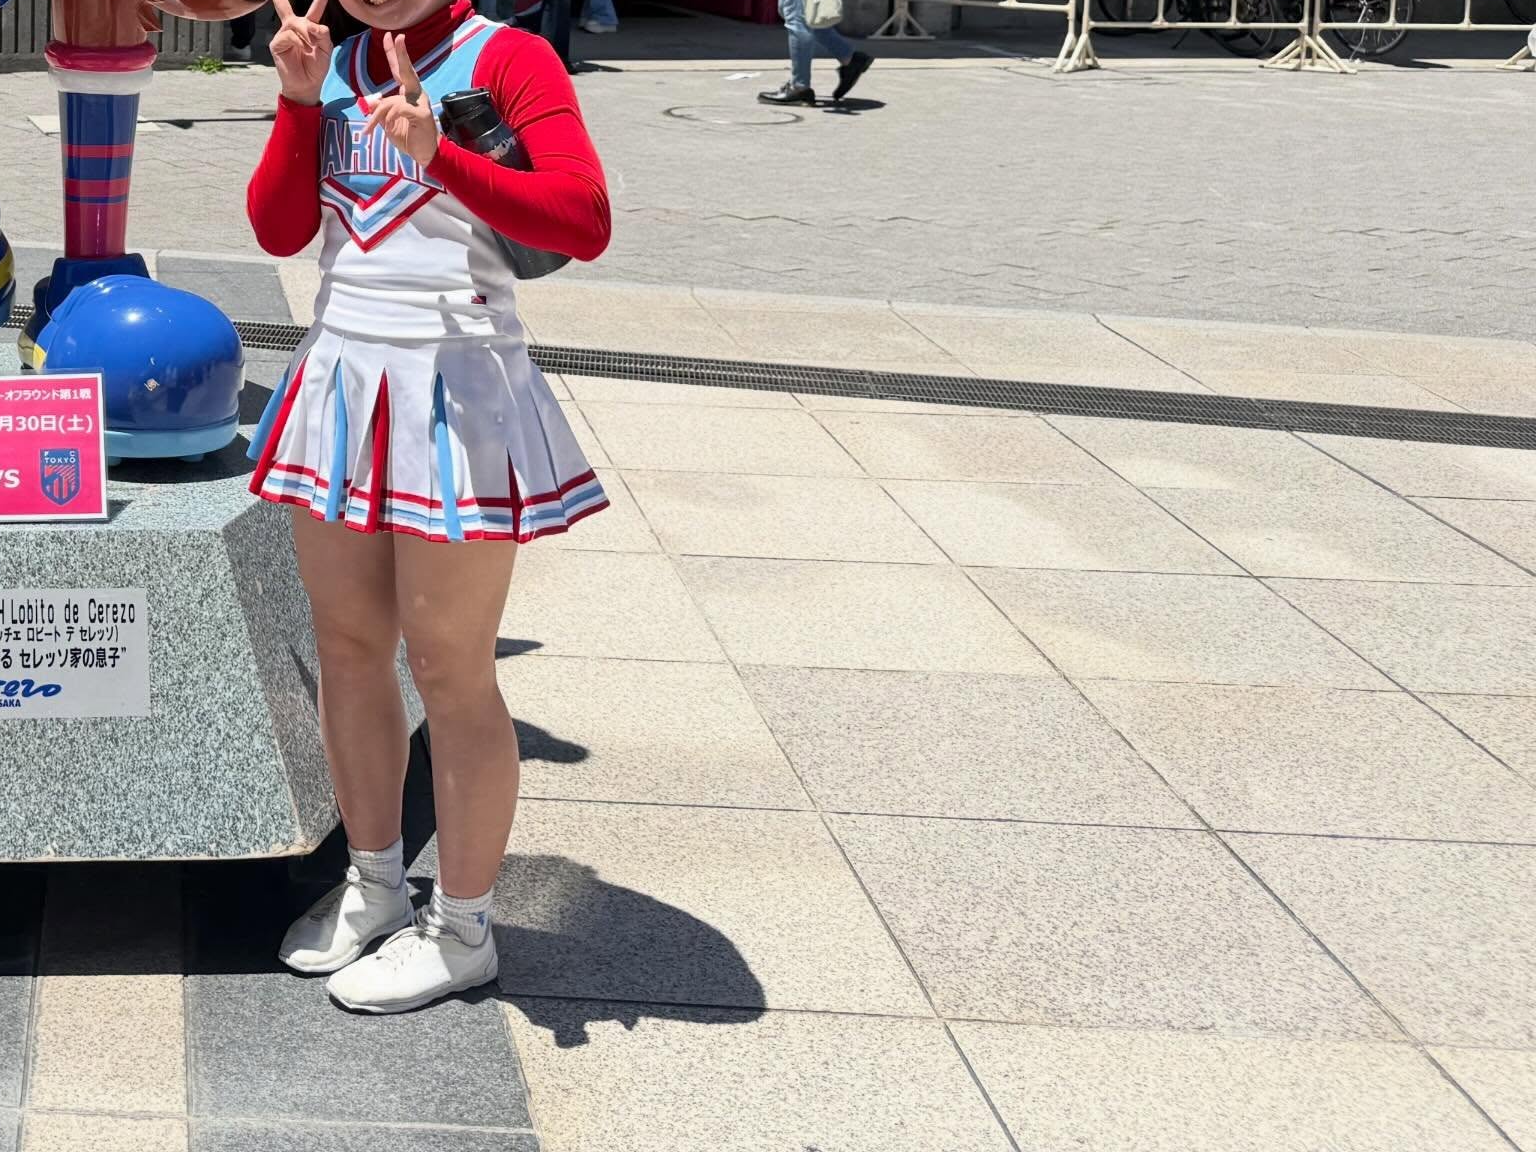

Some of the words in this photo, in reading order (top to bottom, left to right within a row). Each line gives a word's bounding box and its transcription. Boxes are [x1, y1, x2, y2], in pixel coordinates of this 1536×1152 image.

[11, 599, 55, 624] Lobito
[64, 598, 79, 624] de
[88, 598, 136, 624] Cerezo
